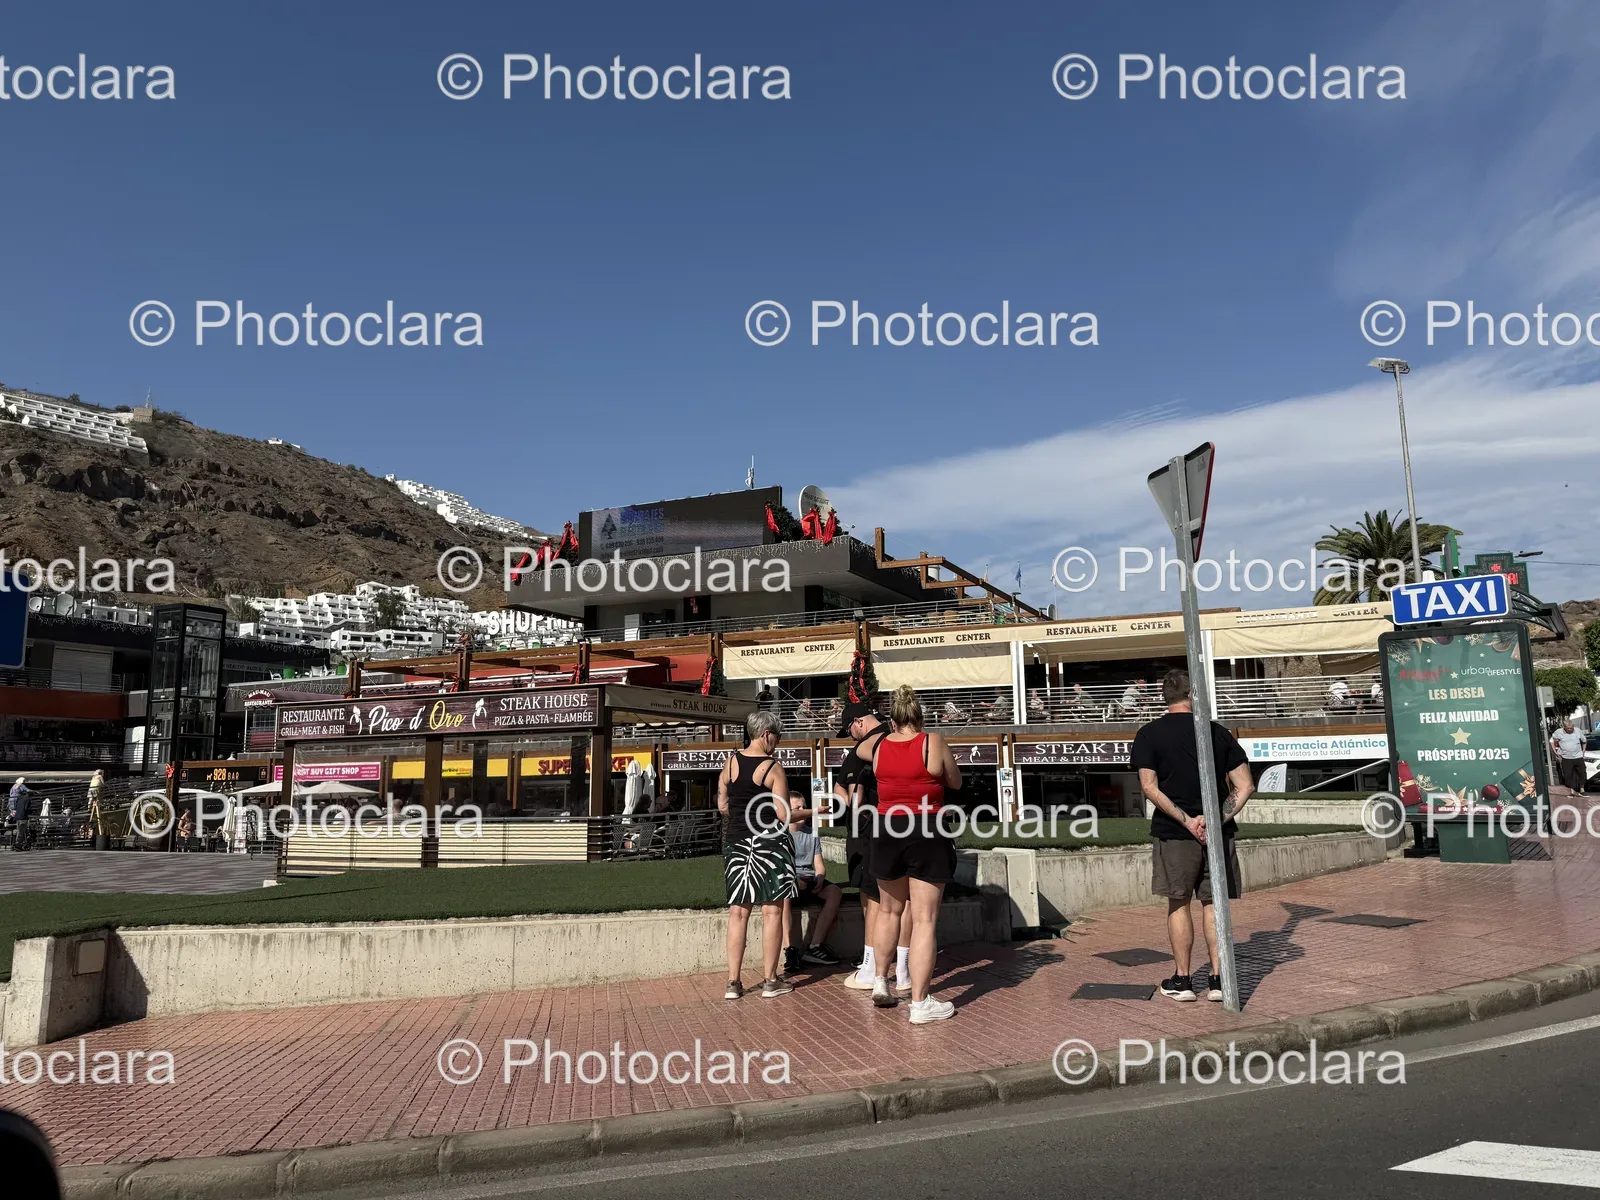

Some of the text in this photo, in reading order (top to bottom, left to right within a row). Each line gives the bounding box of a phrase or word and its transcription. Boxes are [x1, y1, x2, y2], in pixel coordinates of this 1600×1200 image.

[1401, 580, 1498, 619] TAXI
[1046, 620, 1172, 636] RESTAURANTE CENTER
[882, 632, 991, 647] RESTAURANTE CENTER
[740, 643, 835, 656] RESTAURANTE CENTER
[1460, 666, 1490, 676] urban
[1428, 686, 1485, 700] LES DESEA
[500, 694, 588, 710] STEAK HOUSE
[672, 699, 700, 711] STEAK
[702, 702, 728, 714] HOUSE
[282, 708, 345, 722] RESTAURANTE
[368, 705, 404, 734] Pico
[429, 700, 467, 730] Oro
[494, 716, 516, 726] PIZZA
[518, 716, 524, 724] &
[1420, 710, 1499, 724] FELIZ NAVIDAD
[322, 726, 328, 734] &
[329, 725, 344, 734] FISH
[1035, 743, 1108, 754] STEAK
[1272, 738, 1386, 750] Farmacia Atlántico
[1417, 748, 1510, 762] PRÓSPERO 2025
[214, 768, 240, 780] 928 BAR
